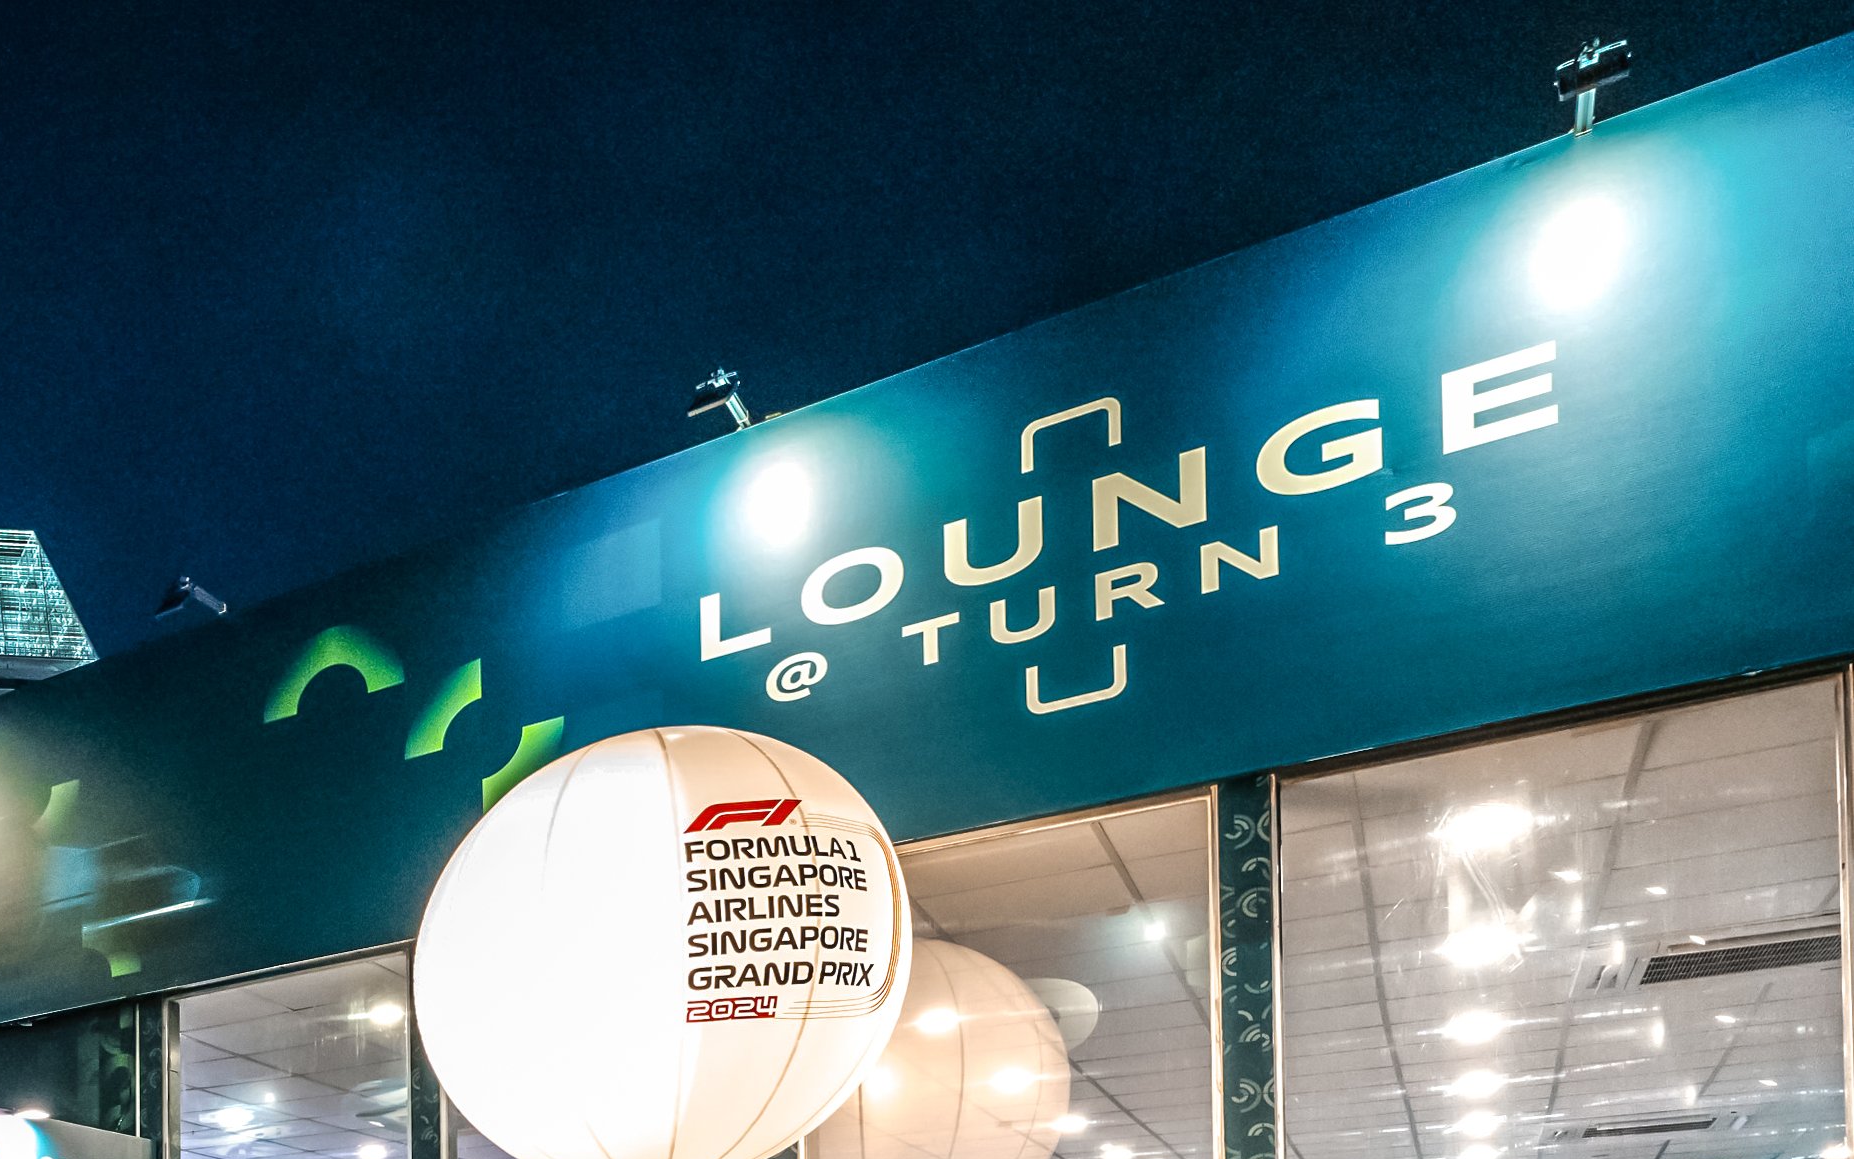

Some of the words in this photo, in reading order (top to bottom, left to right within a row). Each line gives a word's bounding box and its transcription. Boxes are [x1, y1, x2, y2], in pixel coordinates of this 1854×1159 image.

[699, 340, 1559, 662] LOUNGE
[766, 652, 828, 703] @
[902, 526, 1279, 666] TURN
[1385, 482, 1457, 545] 3
[684, 835, 847, 863] FORMULA
[846, 839, 862, 862] 1
[686, 863, 868, 893] SINGAPORE
[687, 893, 841, 926] AIRLINES
[687, 926, 869, 958] SINGAPORE
[687, 960, 815, 991] GRAND
[818, 960, 875, 987] PRIX
[686, 995, 779, 1023] 2024
